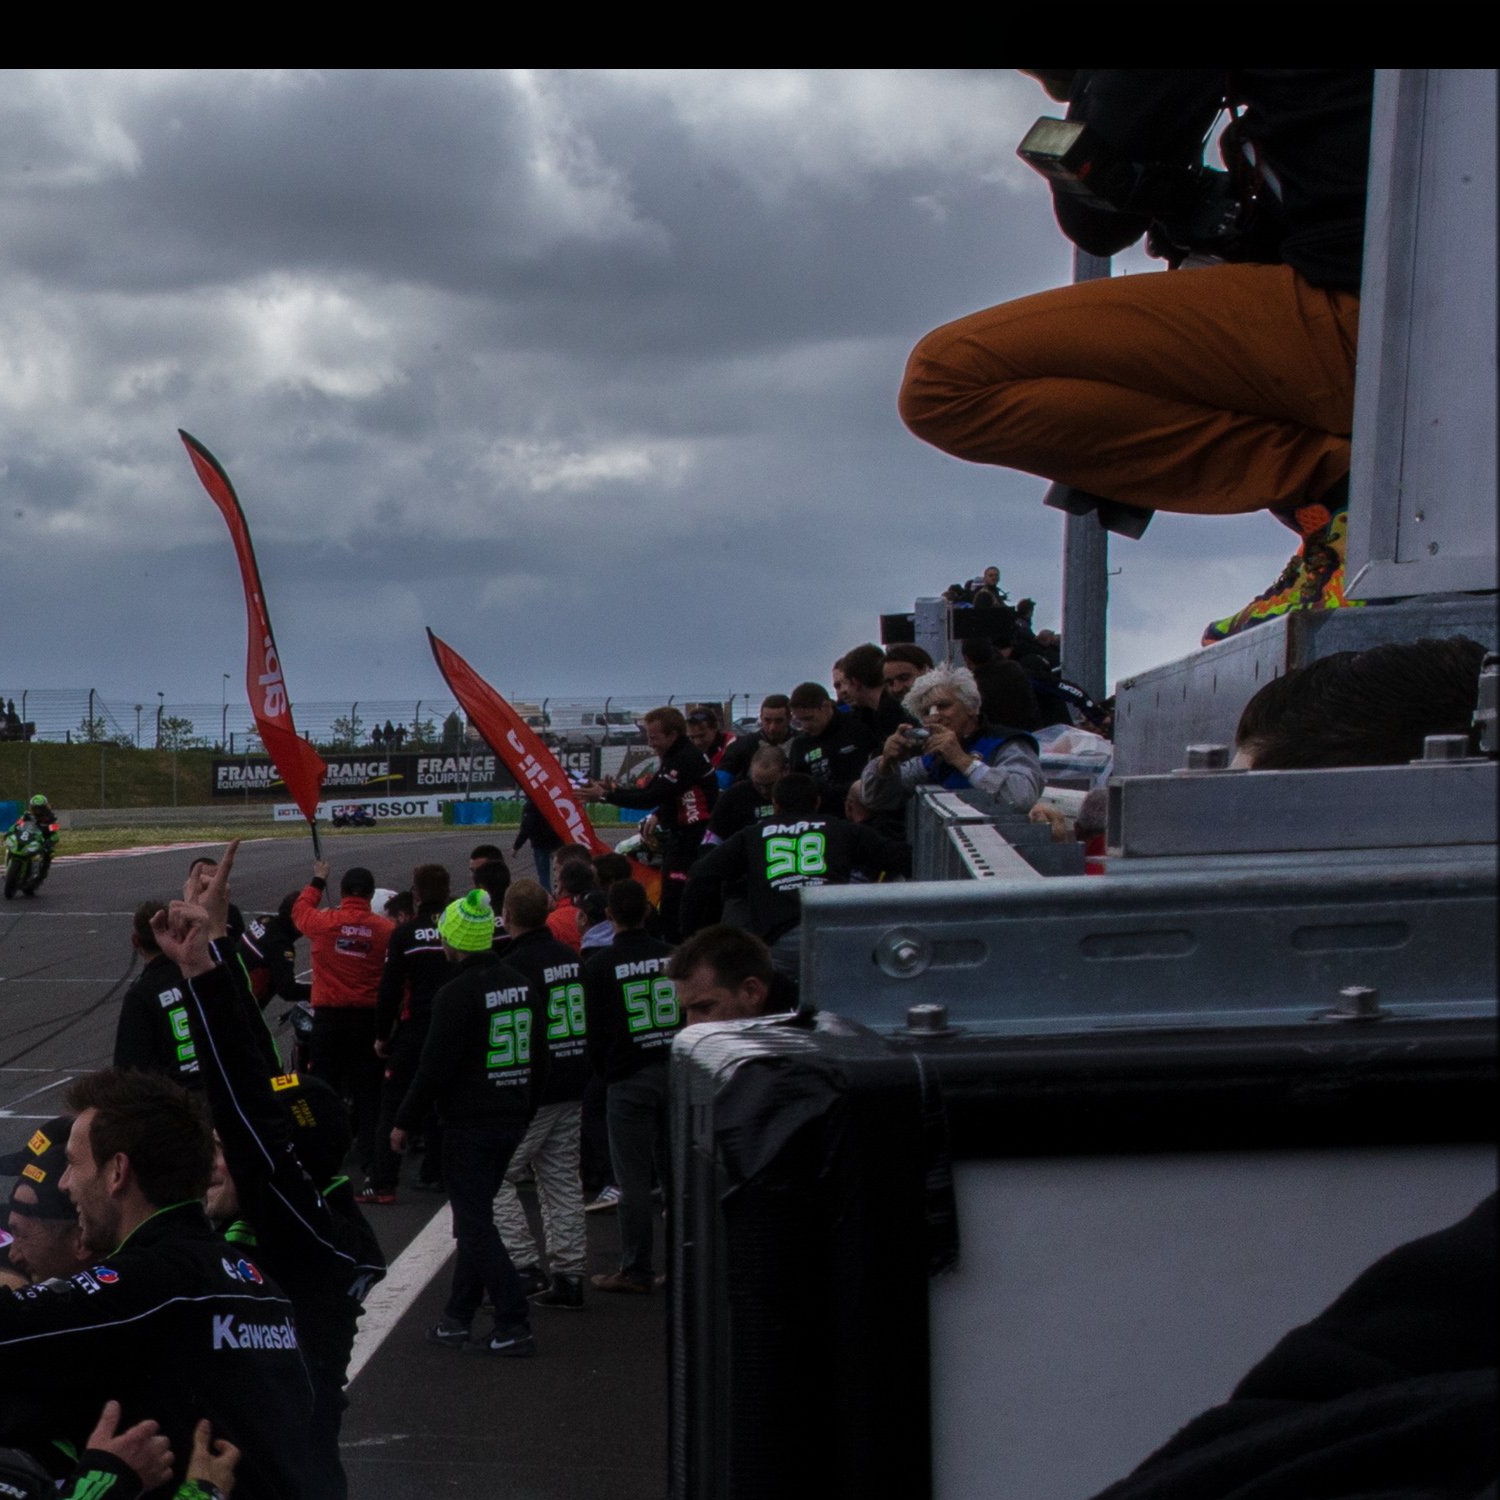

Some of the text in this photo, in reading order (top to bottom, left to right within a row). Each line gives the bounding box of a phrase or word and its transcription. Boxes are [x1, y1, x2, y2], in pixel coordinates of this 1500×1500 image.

[217, 765, 281, 781] FRANC
[326, 761, 390, 778] RANCE
[417, 755, 496, 774] FRANCE
[417, 771, 496, 786] EQUIPEMENT
[765, 831, 829, 880] 58
[547, 983, 588, 1040] 58
[622, 976, 681, 1033] 58
[486, 1007, 533, 1069] 58
